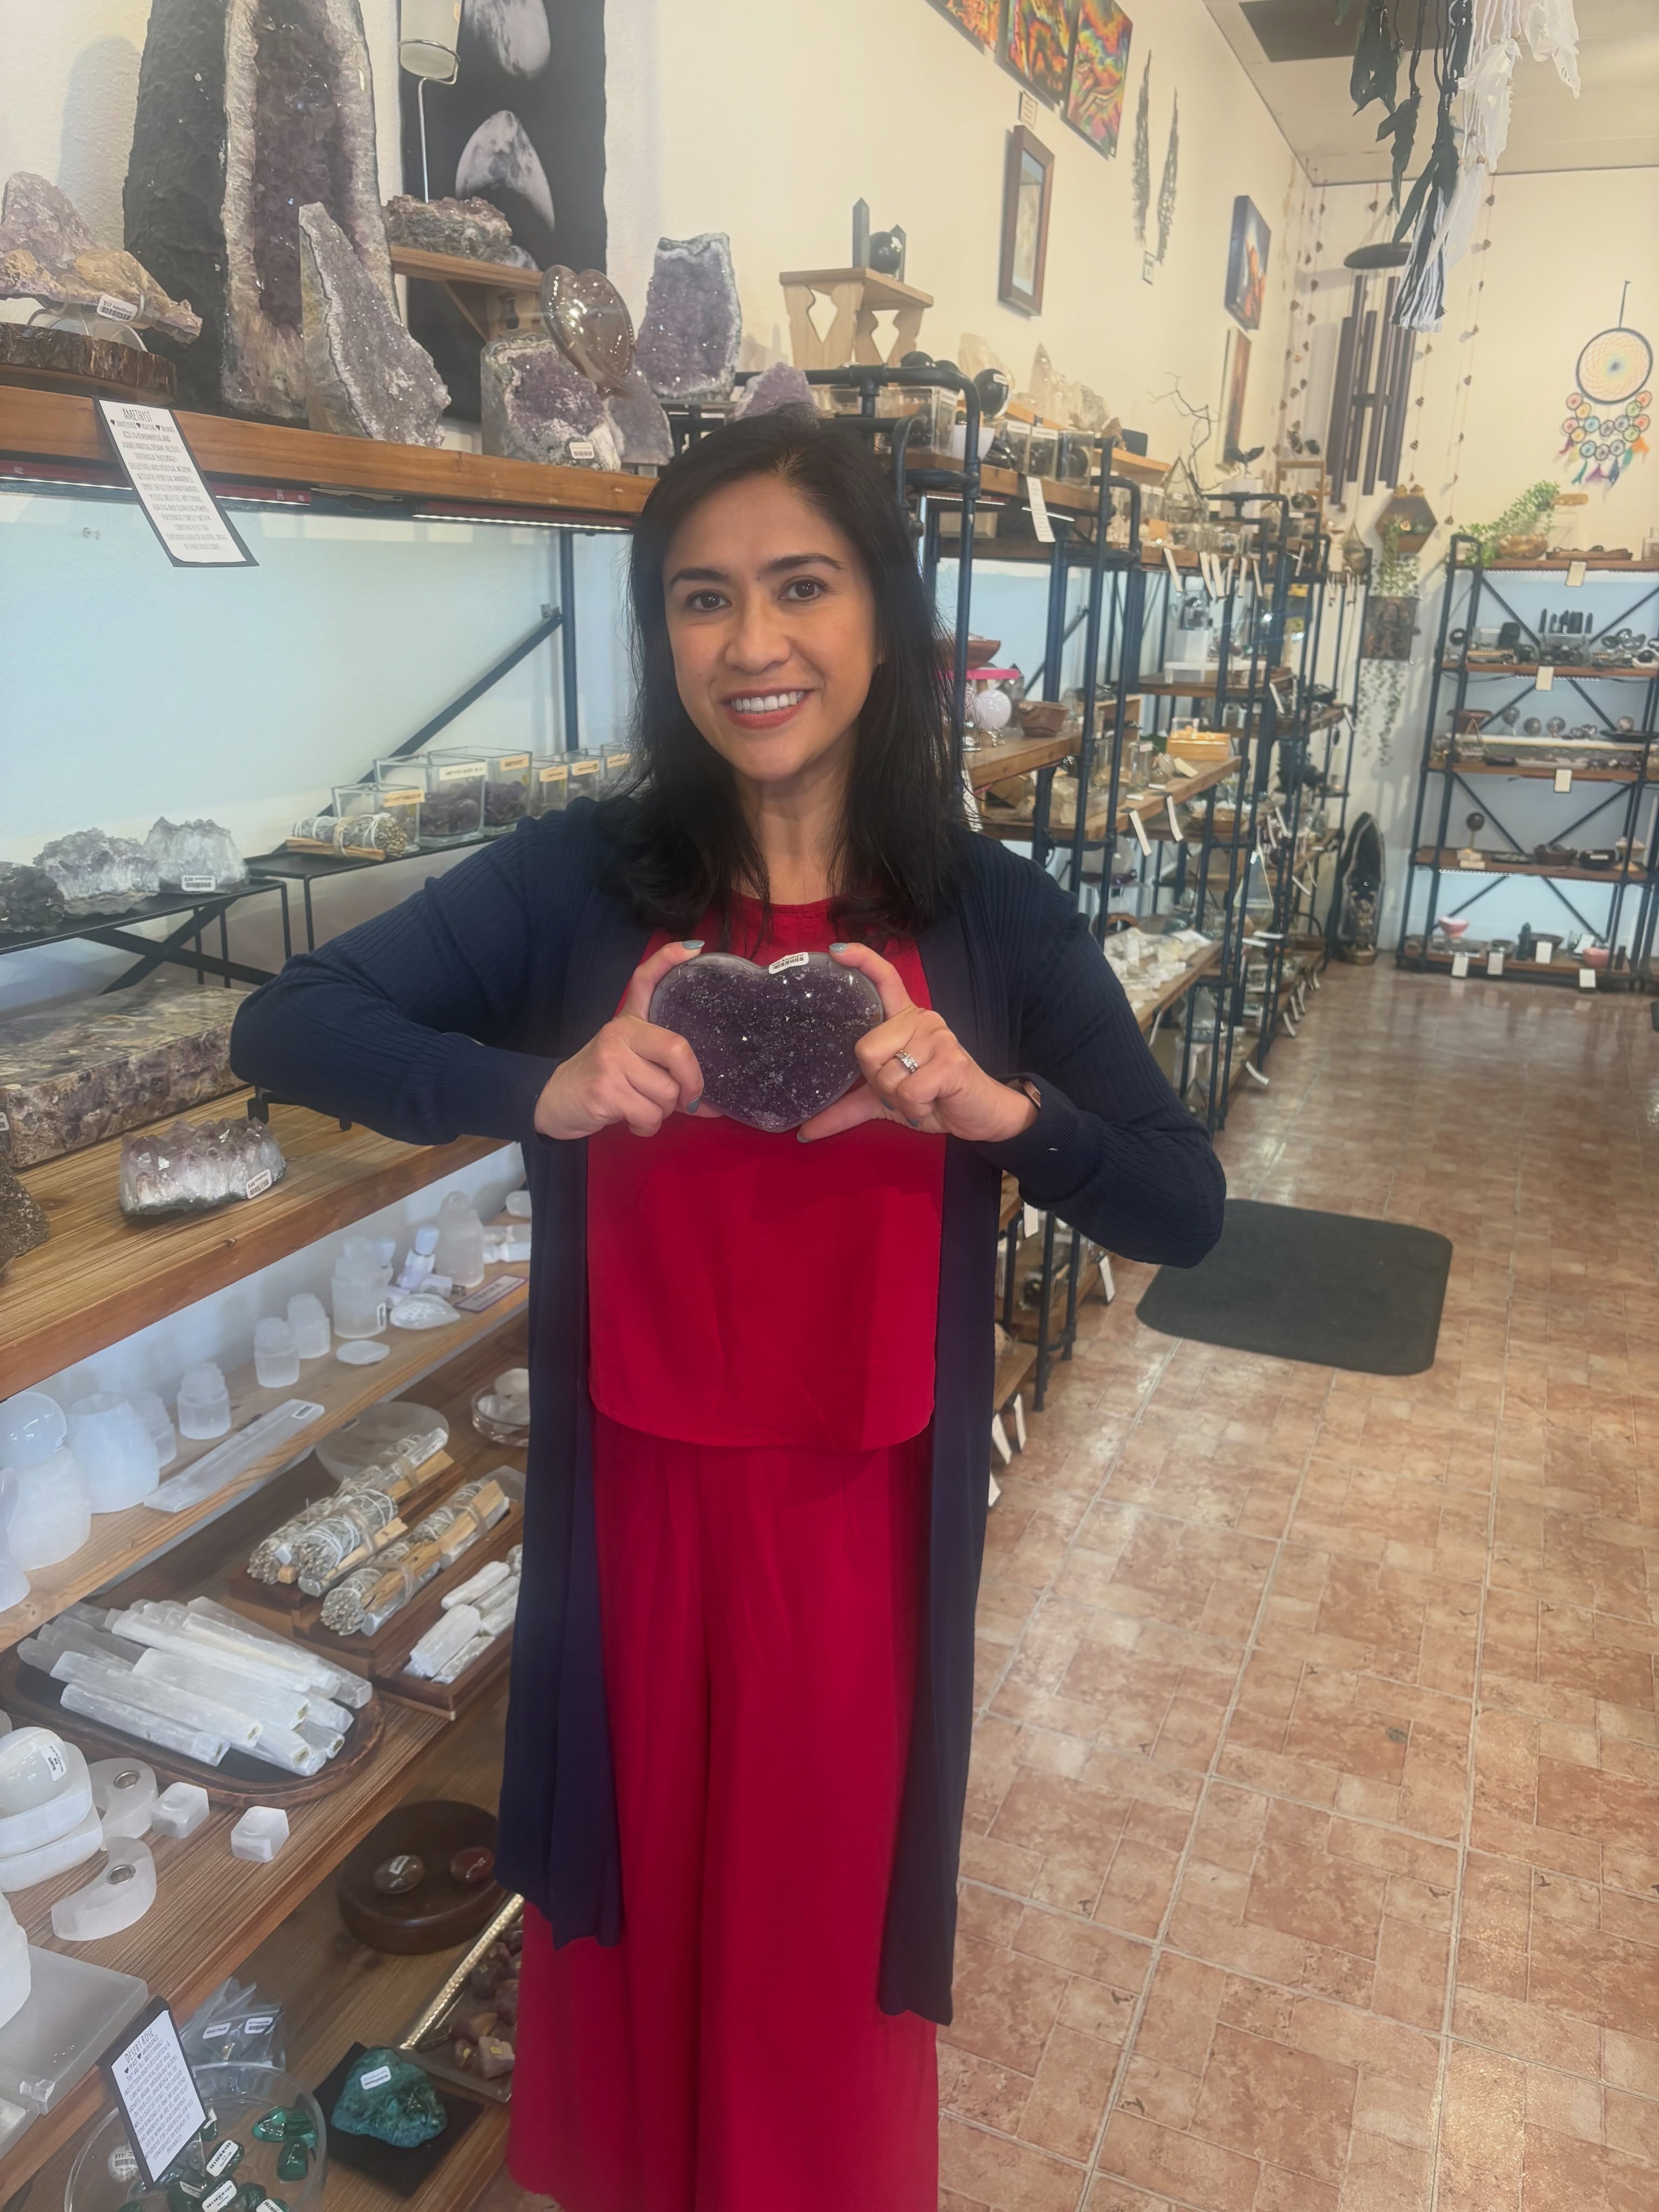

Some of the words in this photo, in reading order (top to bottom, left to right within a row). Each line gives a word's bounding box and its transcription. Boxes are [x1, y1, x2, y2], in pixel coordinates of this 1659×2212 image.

[111, 304, 133, 315] Amethyst
[120, 407, 154, 423] AMETHYST
[782, 954, 804, 962] Amethyst
[124, 2039, 143, 2064] DESERT
[140, 2027, 154, 2046] ROSE
[128, 2057, 138, 2071] PEACE
[141, 2034, 159, 2055] ABUNDANCE
[143, 2049, 153, 2063] ABOUT
[123, 2074, 142, 2096] PROTECTION
